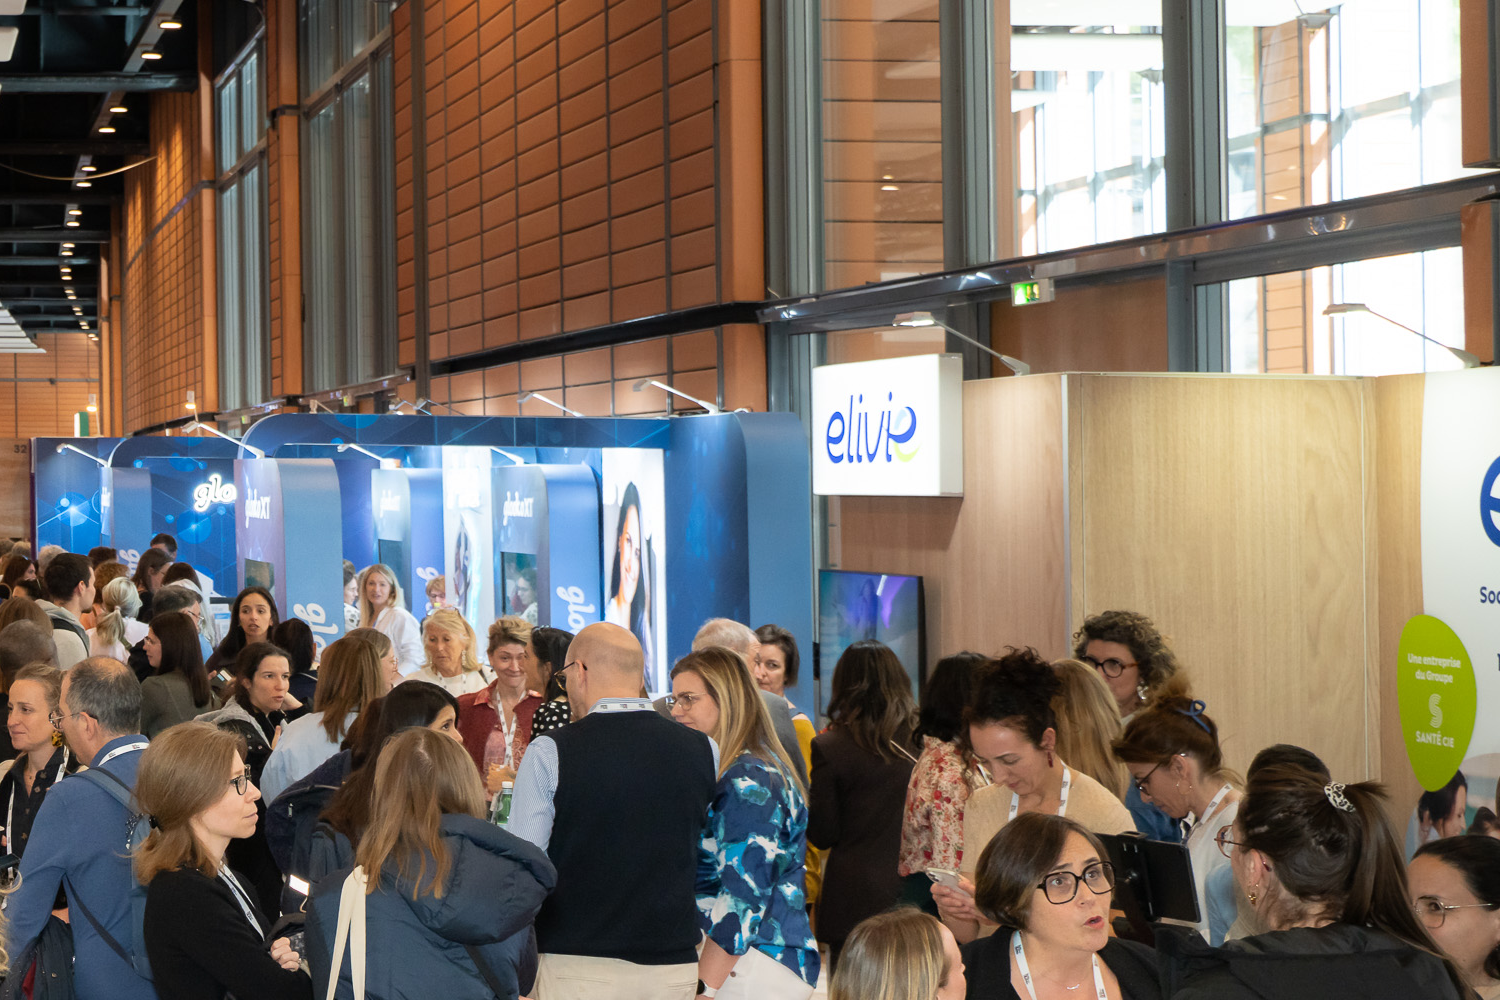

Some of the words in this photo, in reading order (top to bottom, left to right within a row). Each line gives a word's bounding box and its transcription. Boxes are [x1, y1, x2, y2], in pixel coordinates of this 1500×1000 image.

[826, 391, 919, 464] elivie
[13, 444, 28, 454] 32
[1407, 653, 1422, 665] Une
[1422, 655, 1461, 669] entreprise
[1415, 669, 1426, 680] du
[1426, 670, 1453, 685] Groupe
[1415, 730, 1442, 746] SANTÉ
[1442, 736, 1455, 748] CIE
